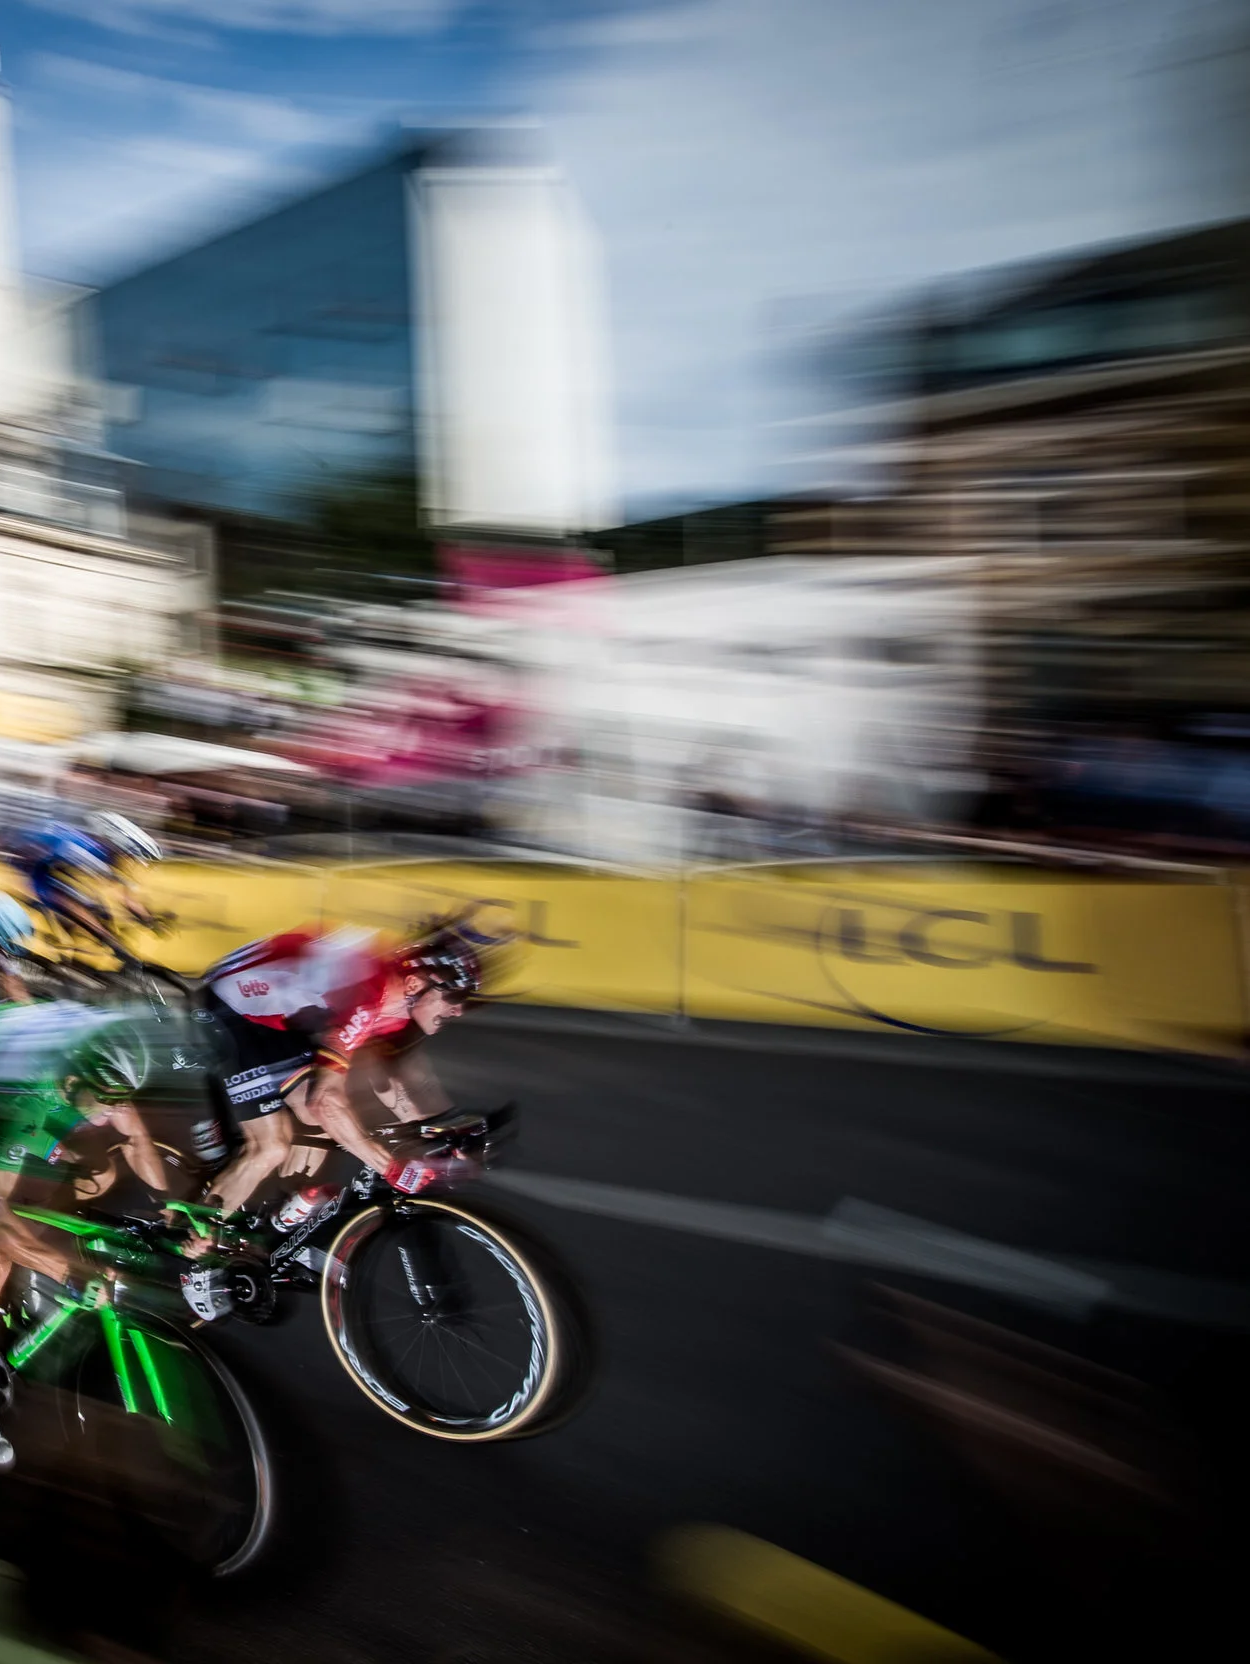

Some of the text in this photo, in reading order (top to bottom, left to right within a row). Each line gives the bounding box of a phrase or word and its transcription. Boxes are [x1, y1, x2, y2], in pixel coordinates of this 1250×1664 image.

[838, 908, 1097, 975] LCL
[223, 1065, 267, 1087] LOTTO
[230, 1083, 276, 1104] SOUDAL
